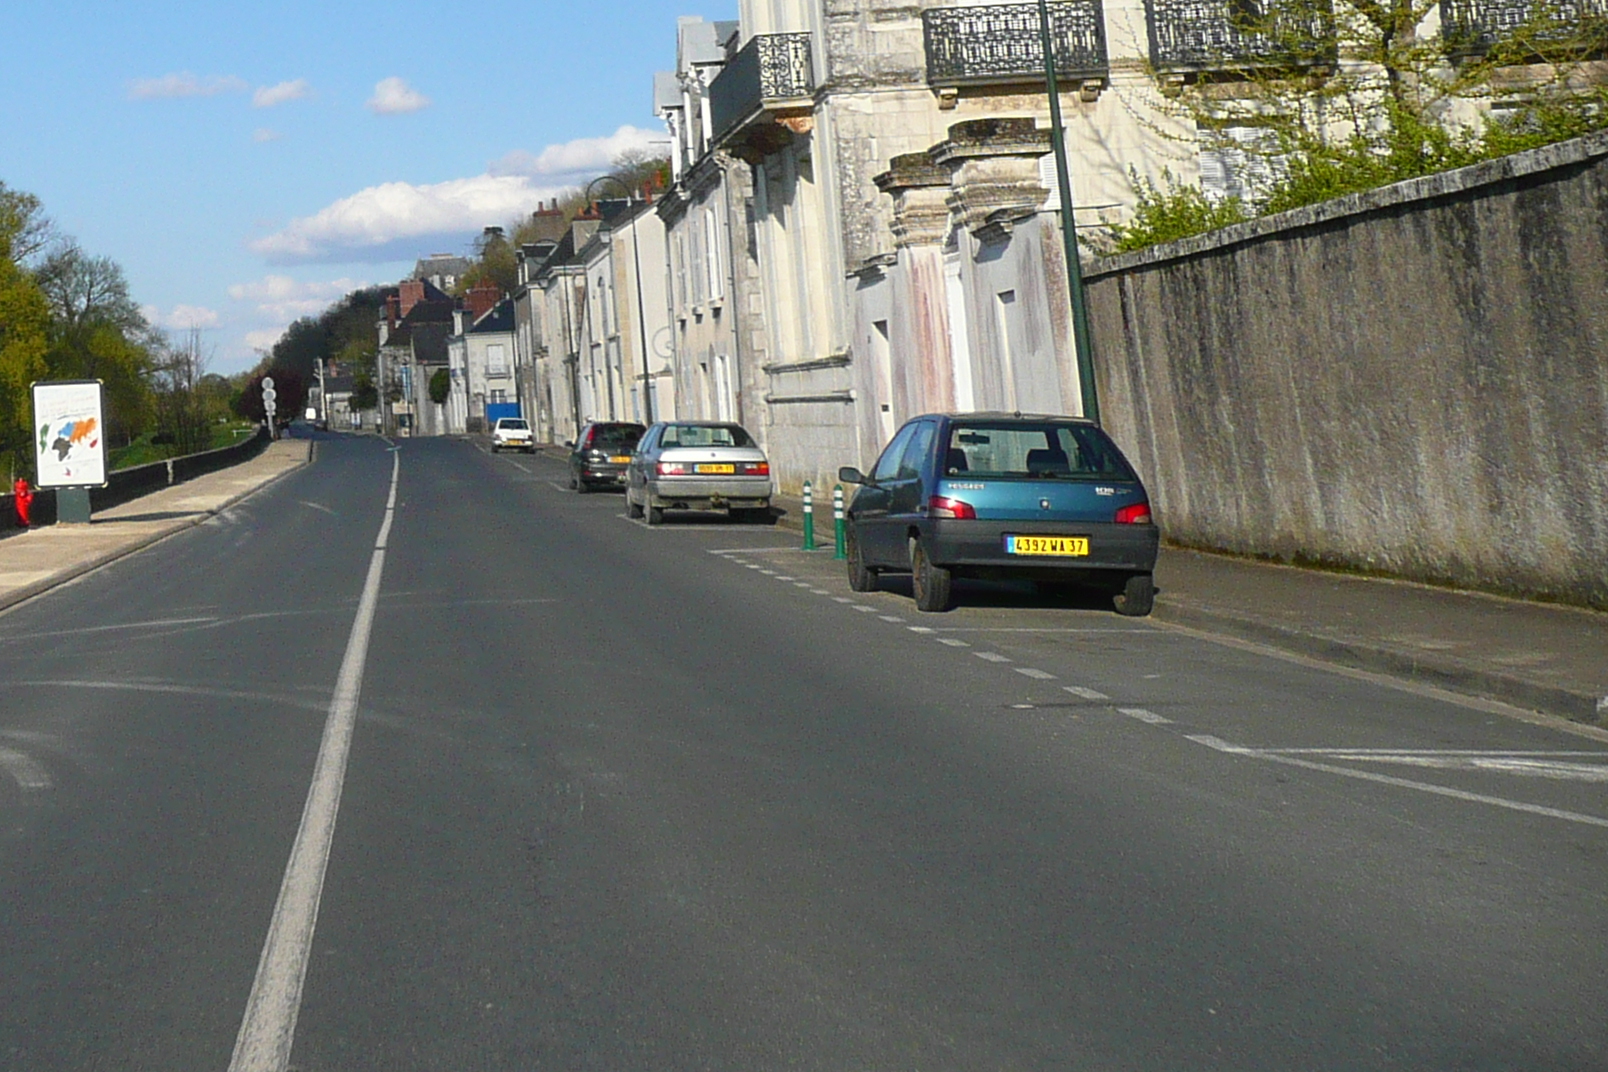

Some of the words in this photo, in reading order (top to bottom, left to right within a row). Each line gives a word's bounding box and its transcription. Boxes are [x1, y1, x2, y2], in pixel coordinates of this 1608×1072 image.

[1016, 538, 1047, 552] 4392
[1050, 539, 1065, 552] WA
[1069, 539, 1084, 553] 37
